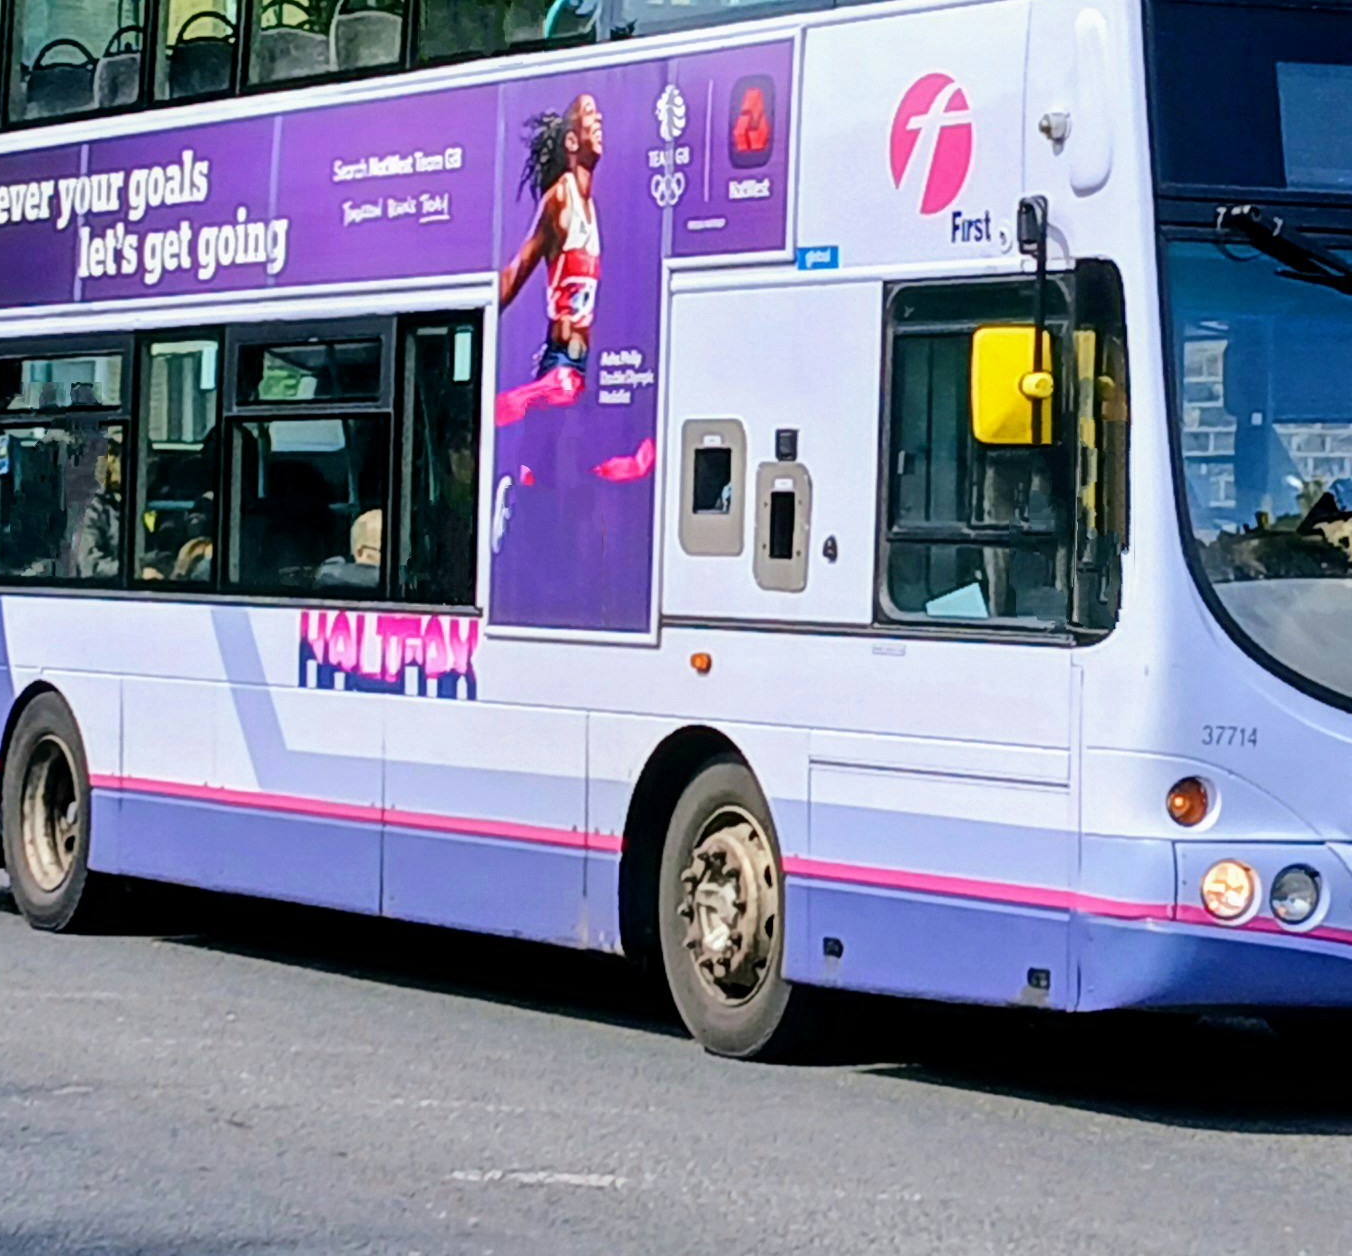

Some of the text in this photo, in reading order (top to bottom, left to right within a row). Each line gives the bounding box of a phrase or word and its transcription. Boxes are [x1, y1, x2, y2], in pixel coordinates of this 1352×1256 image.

[56, 170, 125, 230] your
[128, 149, 210, 221] goals
[78, 221, 139, 279] let's
[144, 220, 193, 285] get
[197, 206, 290, 281] going
[951, 210, 992, 243] First
[1201, 724, 1258, 747] 37714
